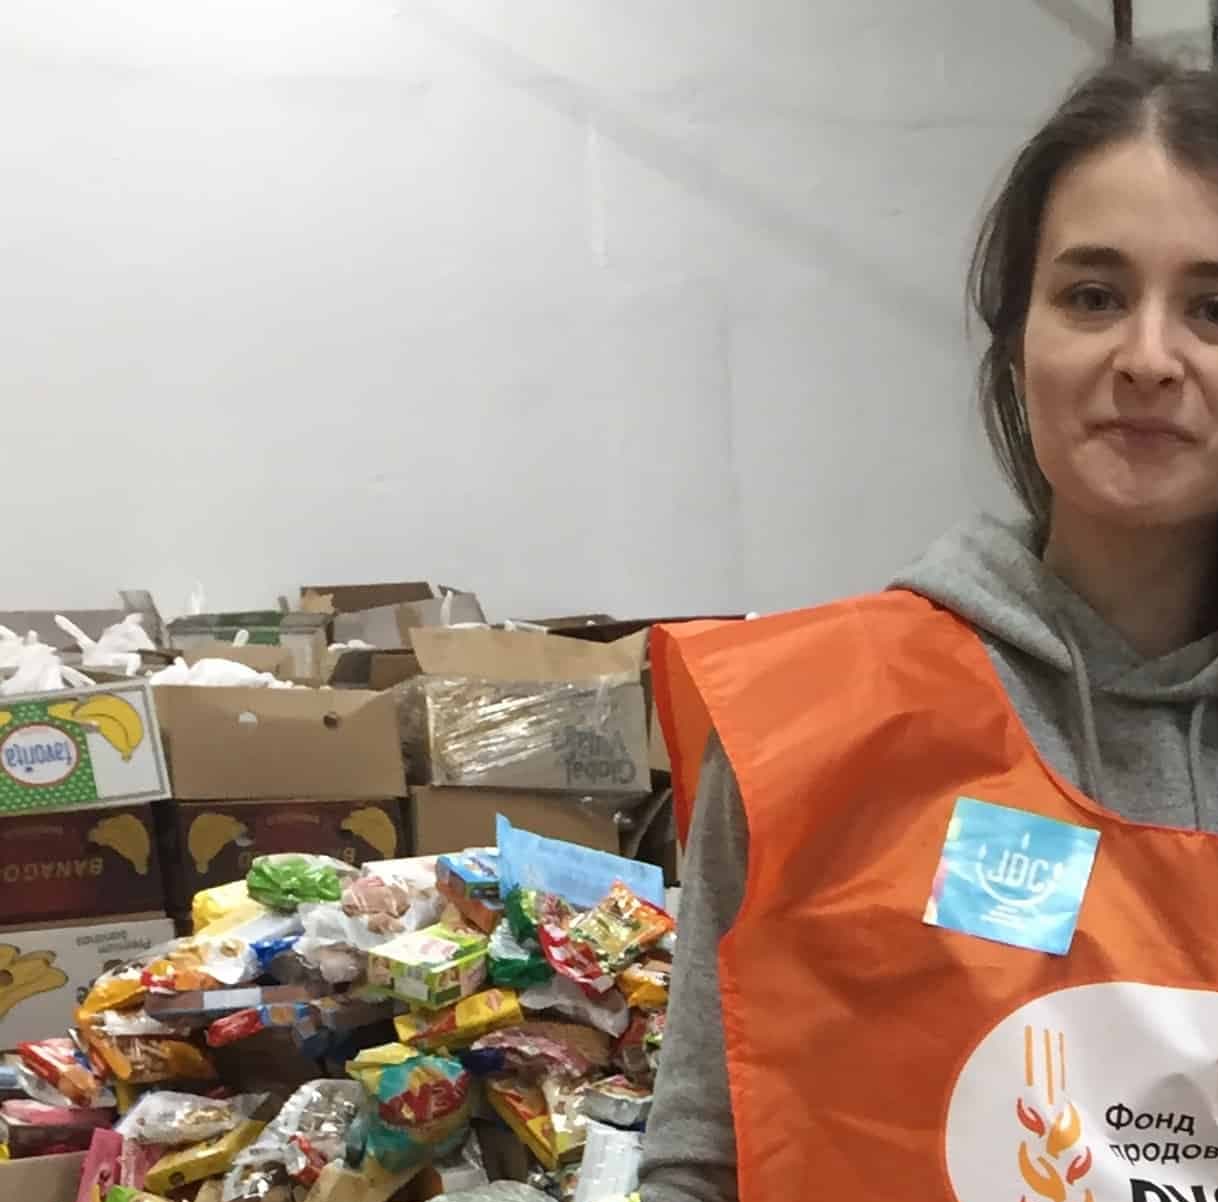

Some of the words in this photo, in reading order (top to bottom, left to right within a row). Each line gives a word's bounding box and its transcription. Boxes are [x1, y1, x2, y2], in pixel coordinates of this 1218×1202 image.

[5, 742, 72, 773] favorita
[986, 849, 1049, 893] JDC
[1105, 1103, 1195, 1136] Фонд
